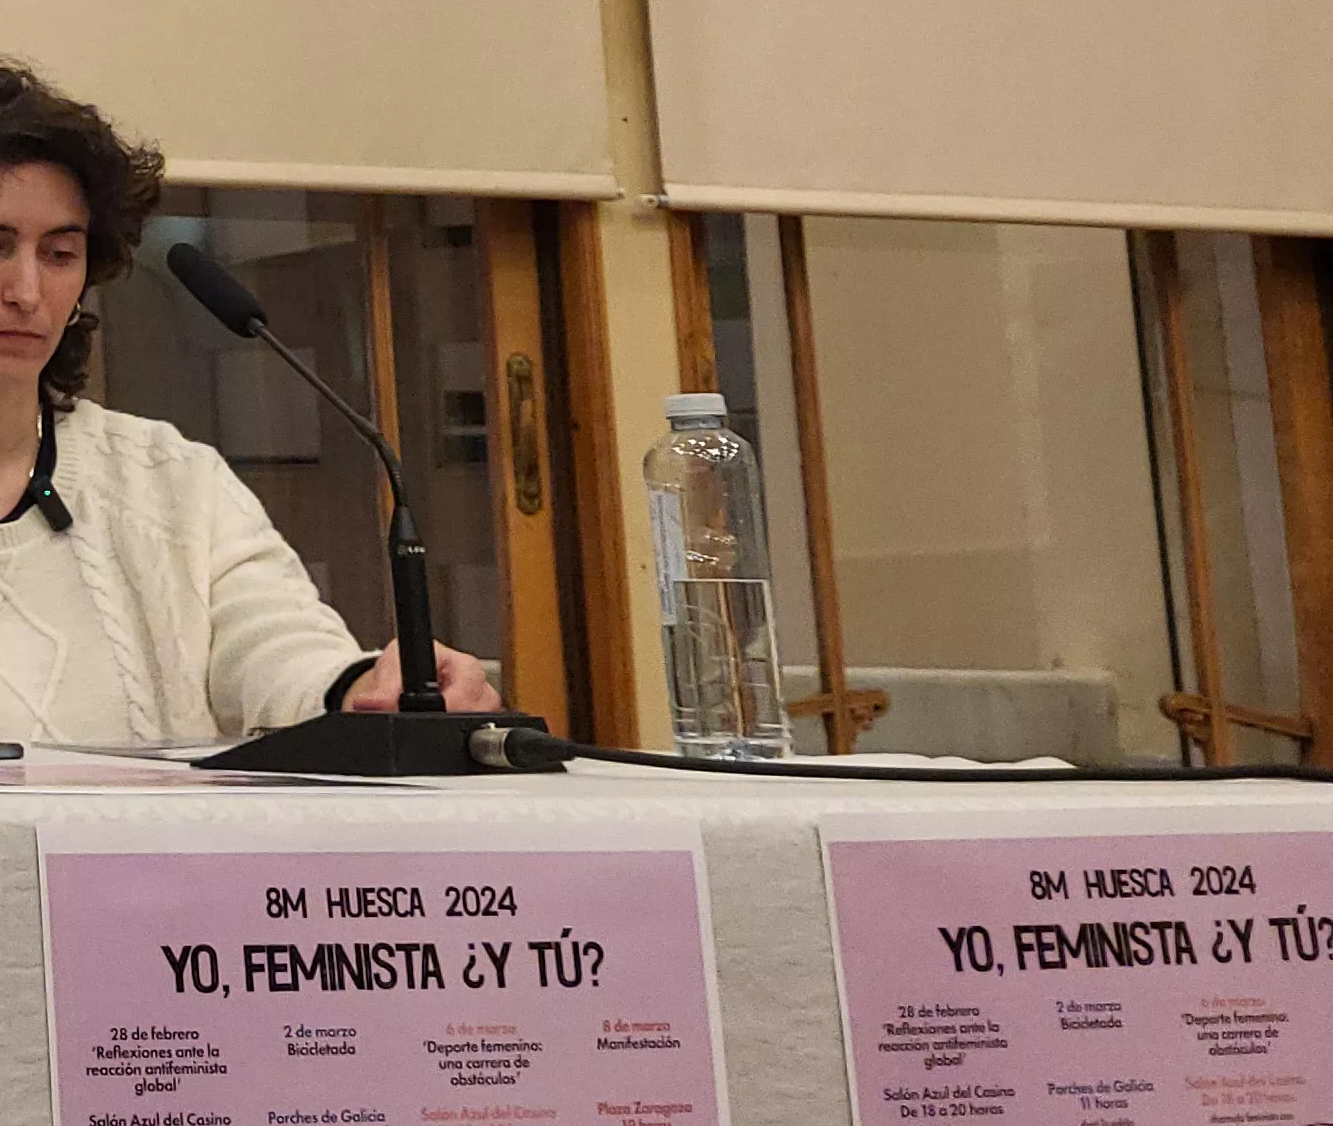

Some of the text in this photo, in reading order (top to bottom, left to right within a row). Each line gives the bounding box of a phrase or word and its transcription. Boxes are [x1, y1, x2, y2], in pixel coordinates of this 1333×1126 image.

[1030, 865, 1256, 900] 8M HUESCA 2024
[265, 885, 517, 919] 8M HUESCA 2024
[939, 926, 1004, 976] YO,
[1013, 920, 1197, 970] FEMINISTA
[1212, 918, 1253, 963] ¿Y
[161, 927, 605, 999] YO, FEMINISTA ¿Y TÚ?
[898, 1004, 979, 1018] 28 de febrero
[110, 1026, 200, 1041] 28 de febrero
[284, 1024, 357, 1038] 2 de marzo
[457, 1023, 473, 1035] de
[603, 1020, 670, 1032] 8 de marzo
[175, 1045, 204, 1058] ante
[207, 1043, 220, 1058] la
[287, 1042, 356, 1056] Bicicletada
[481, 1039, 543, 1053] femenino:
[597, 1037, 681, 1050] Manifestación
[86, 1059, 227, 1076] reacción antifeminista
[439, 1055, 530, 1070] una carrera de
[922, 1086, 950, 1100] Azul
[953, 1085, 971, 1099] del
[321, 1109, 337, 1123] de
[340, 1108, 386, 1122] Galicia
[901, 1105, 917, 1118] De
[949, 1103, 966, 1116] 20
[89, 1112, 232, 1126] Salón Azul del Casino
